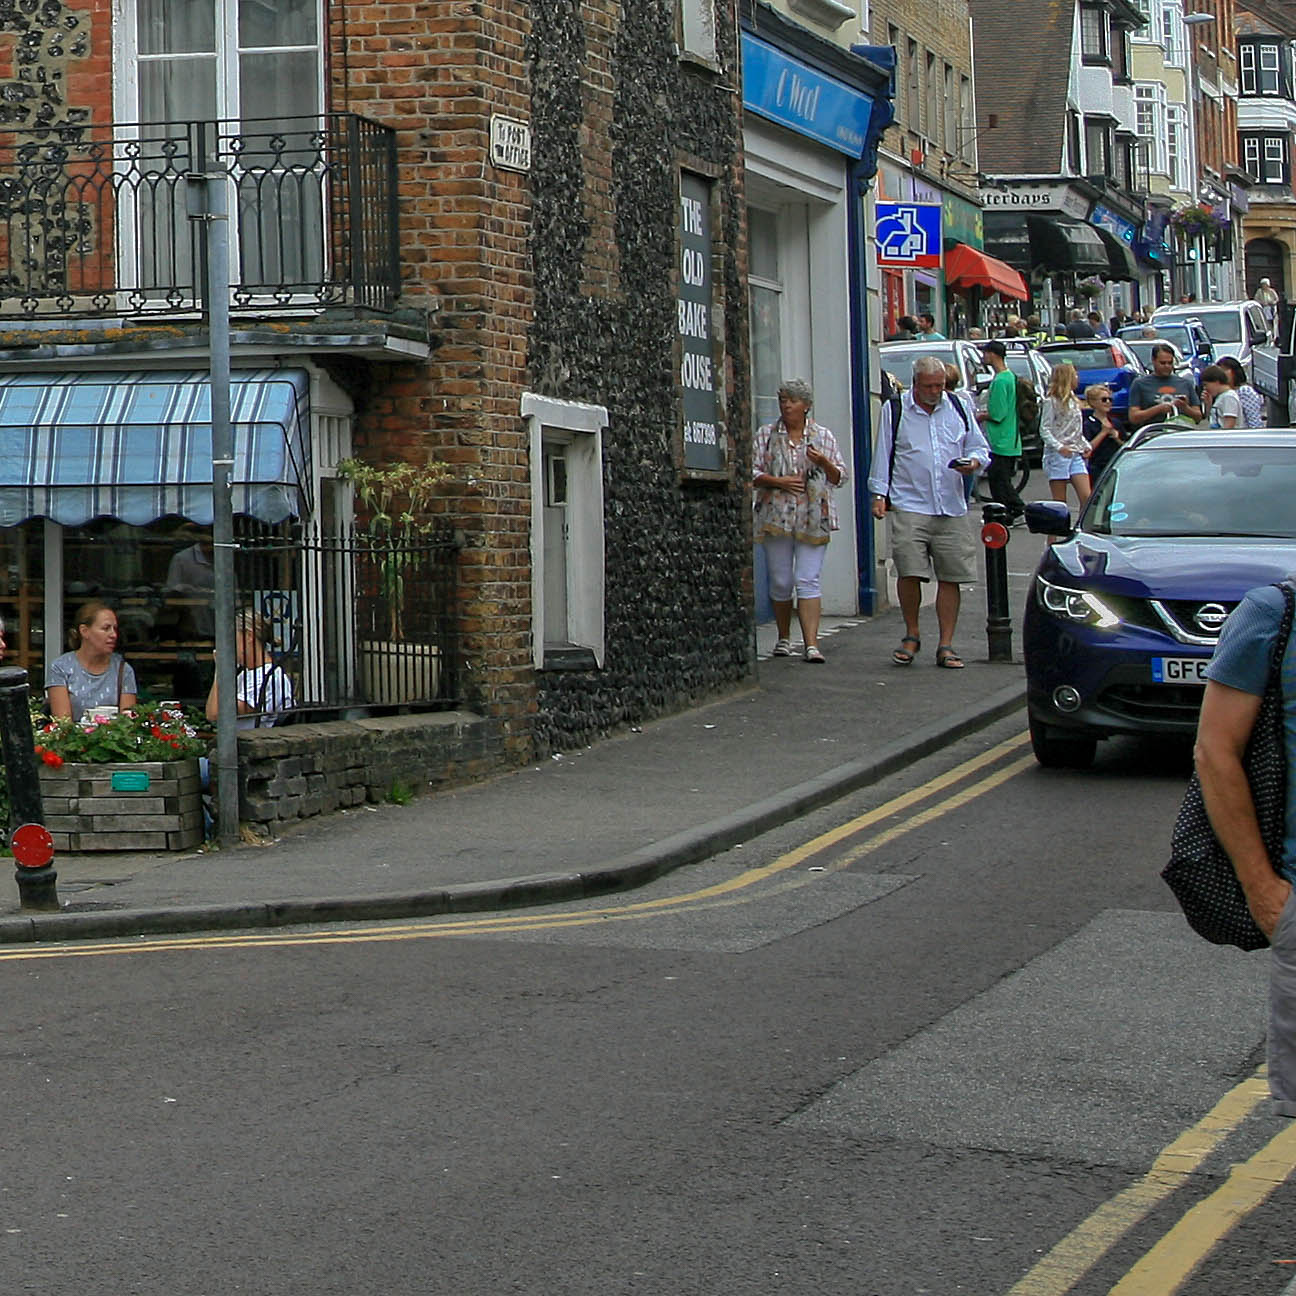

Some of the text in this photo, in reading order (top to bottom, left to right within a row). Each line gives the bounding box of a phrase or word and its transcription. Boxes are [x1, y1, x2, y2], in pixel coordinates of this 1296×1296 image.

[508, 125, 525, 146] POST
[505, 145, 529, 167] OFFICE
[681, 196, 703, 236] THE
[683, 248, 704, 286] OLD
[678, 299, 707, 339] BAKE
[681, 352, 712, 391] OUSE
